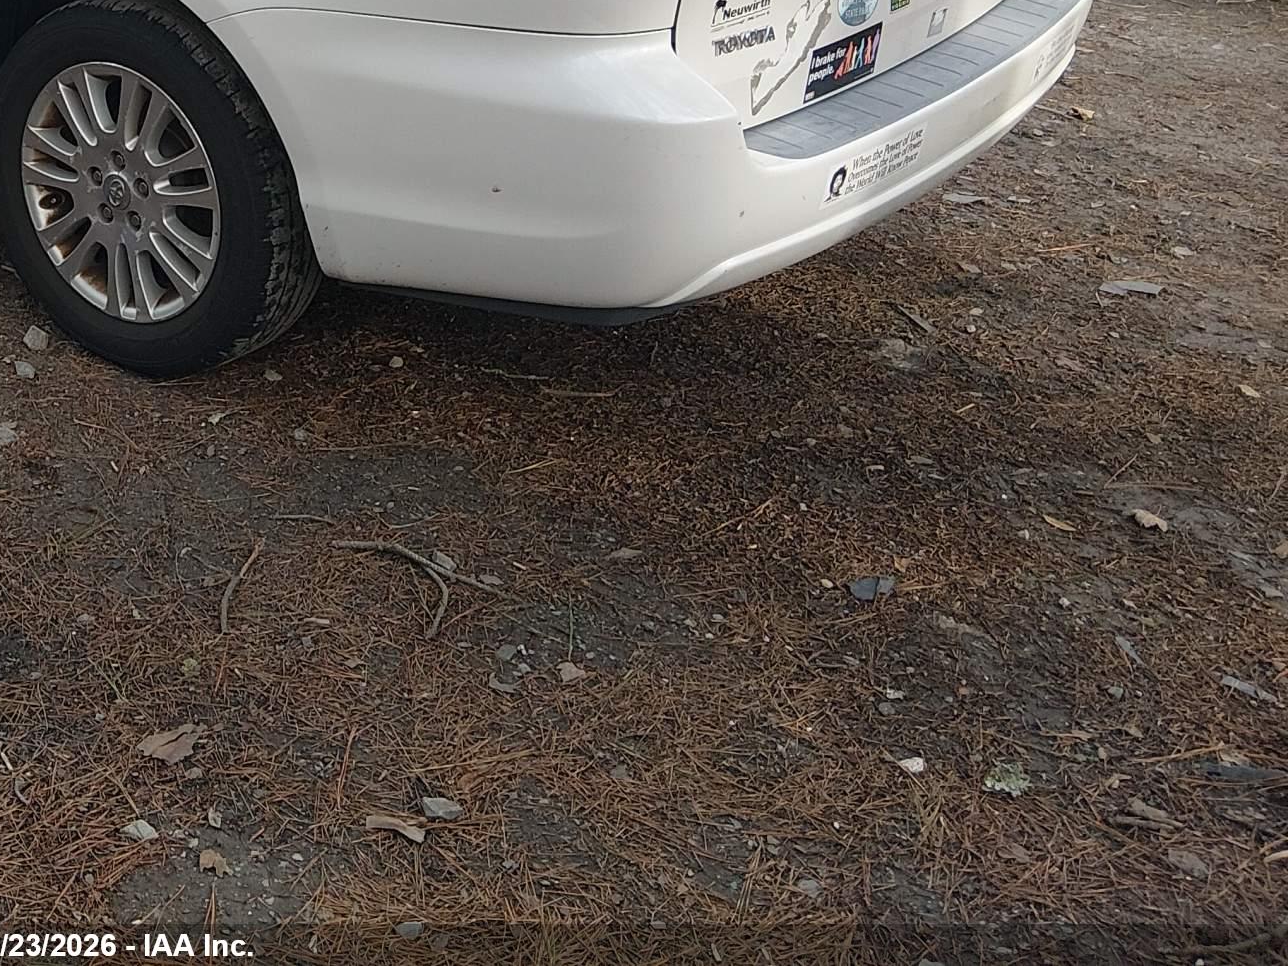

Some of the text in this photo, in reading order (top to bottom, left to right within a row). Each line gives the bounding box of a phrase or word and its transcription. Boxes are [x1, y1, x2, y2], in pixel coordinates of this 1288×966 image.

[815, 51, 836, 68] brake
[836, 47, 846, 63] for
[809, 65, 835, 85] people.
